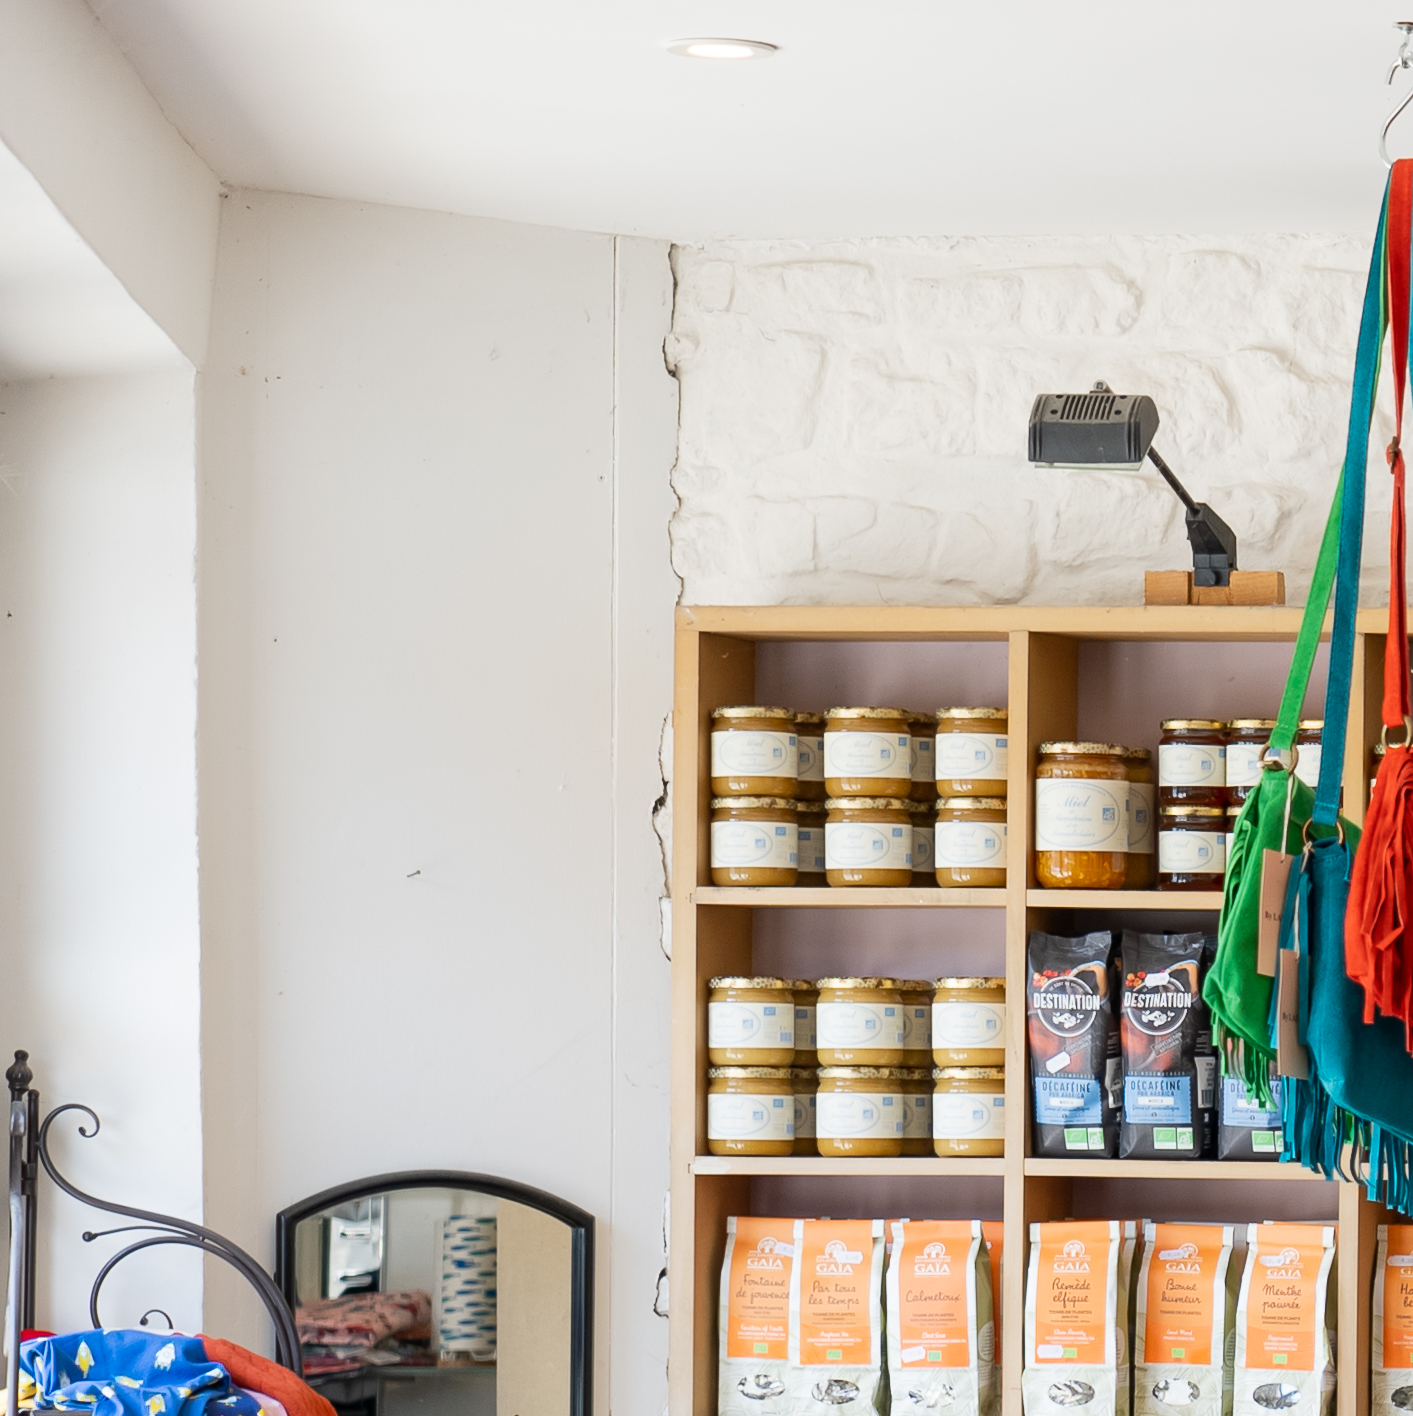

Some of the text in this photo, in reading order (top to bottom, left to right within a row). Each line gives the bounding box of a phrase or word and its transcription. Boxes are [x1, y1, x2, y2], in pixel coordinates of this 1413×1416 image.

[1033, 993, 1100, 1010] DESTINATION
[1124, 990, 1192, 1009] DESTINATION
[1042, 1081, 1091, 1093] DÉCAFÉINÉ
[1131, 1080, 1181, 1091] DÉCAFÉINÉ
[747, 1256, 783, 1268] GAÏA
[914, 1262, 950, 1273] GAÏA
[1053, 1261, 1090, 1271] GAÏA
[1165, 1262, 1201, 1272] GAÏA
[1266, 1268, 1301, 1277] GAÏA
[744, 1274, 785, 1287] Fontaine
[812, 1280, 856, 1293] Par tous
[1052, 1277, 1092, 1291] Remède
[1166, 1278, 1198, 1291] Bonne
[906, 1290, 961, 1303] Calmetoux
[1262, 1284, 1302, 1296] Menthe
[808, 1293, 860, 1309] les temps
[1052, 1292, 1089, 1308] elfique
[1161, 1291, 1202, 1304] humeur
[1262, 1298, 1302, 1313] poivrée
